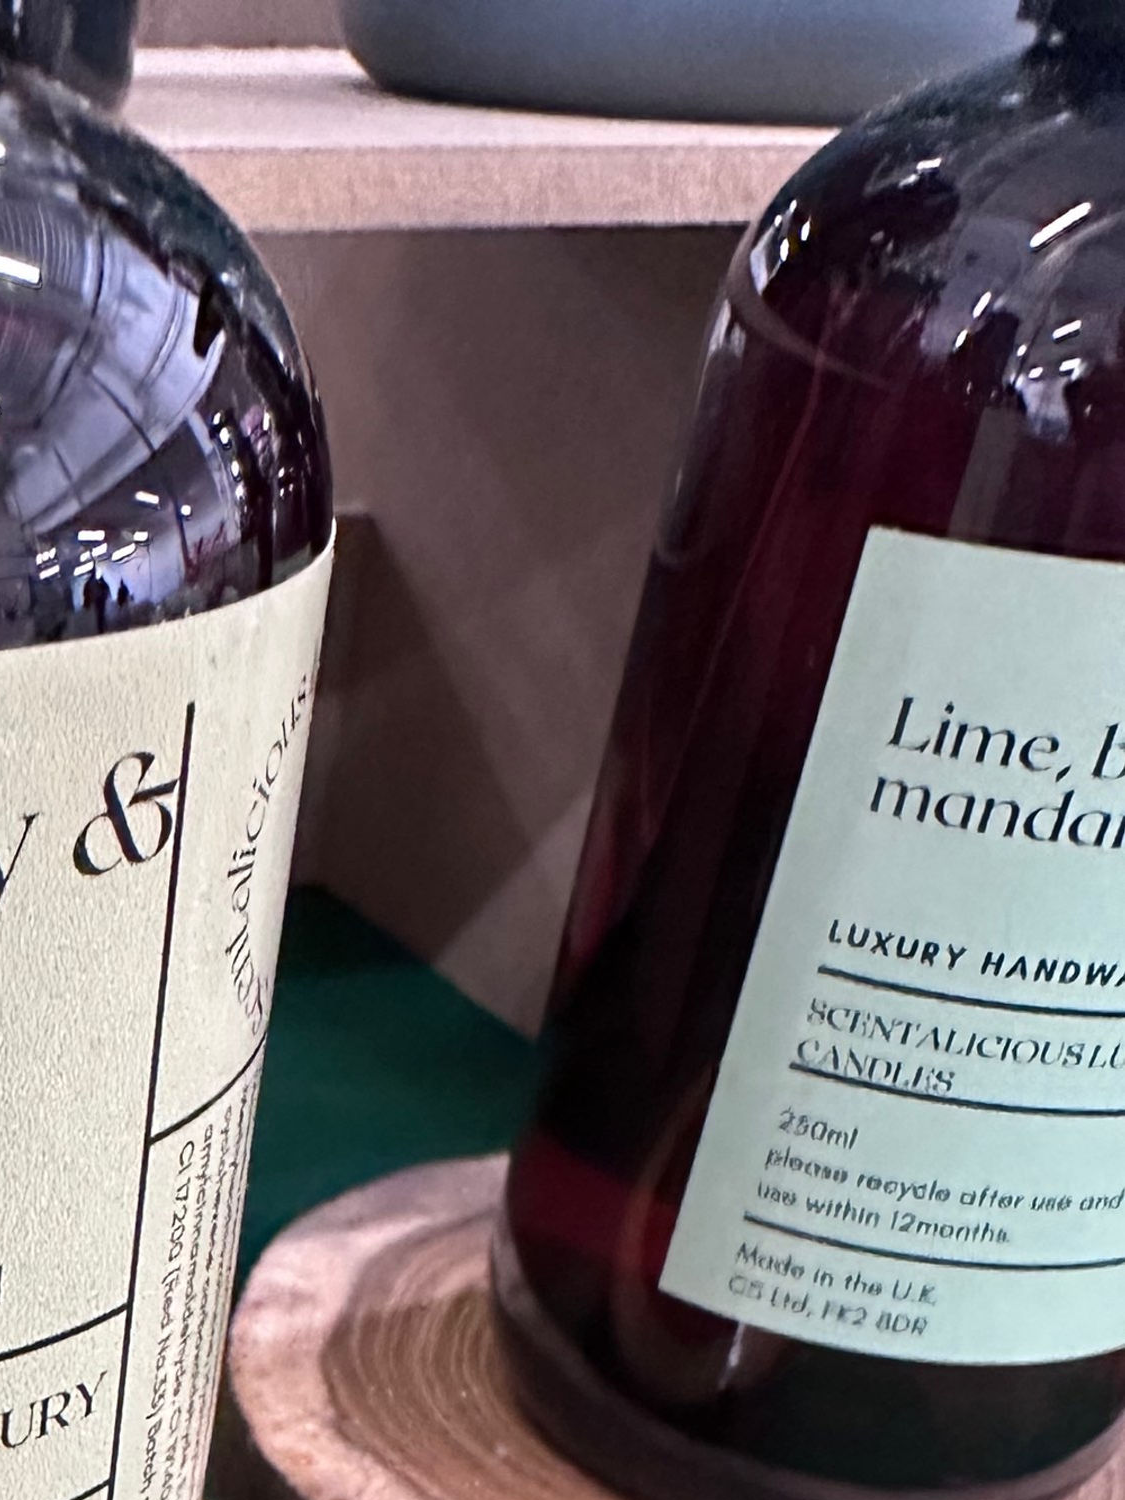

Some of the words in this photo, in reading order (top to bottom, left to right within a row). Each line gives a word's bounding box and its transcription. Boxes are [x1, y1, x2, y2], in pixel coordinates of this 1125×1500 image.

[888, 696, 1072, 783] Lime,
[71, 750, 179, 876] &
[828, 918, 968, 970] LUXURY
[807, 998, 1085, 1070] SCENTALICIOUS
[797, 1039, 955, 1092] CANDLES
[778, 1107, 859, 1149] 250ml
[757, 1182, 797, 1206] use
[807, 1198, 880, 1227] within
[764, 1147, 849, 1185] please
[857, 1173, 951, 1203] recycle
[959, 1185, 1025, 1209] after
[1030, 1194, 1073, 1212] use
[1079, 1187, 1125, 1212] and
[736, 1242, 805, 1278] Made
[813, 1267, 834, 1288] in
[844, 1272, 882, 1296] the
